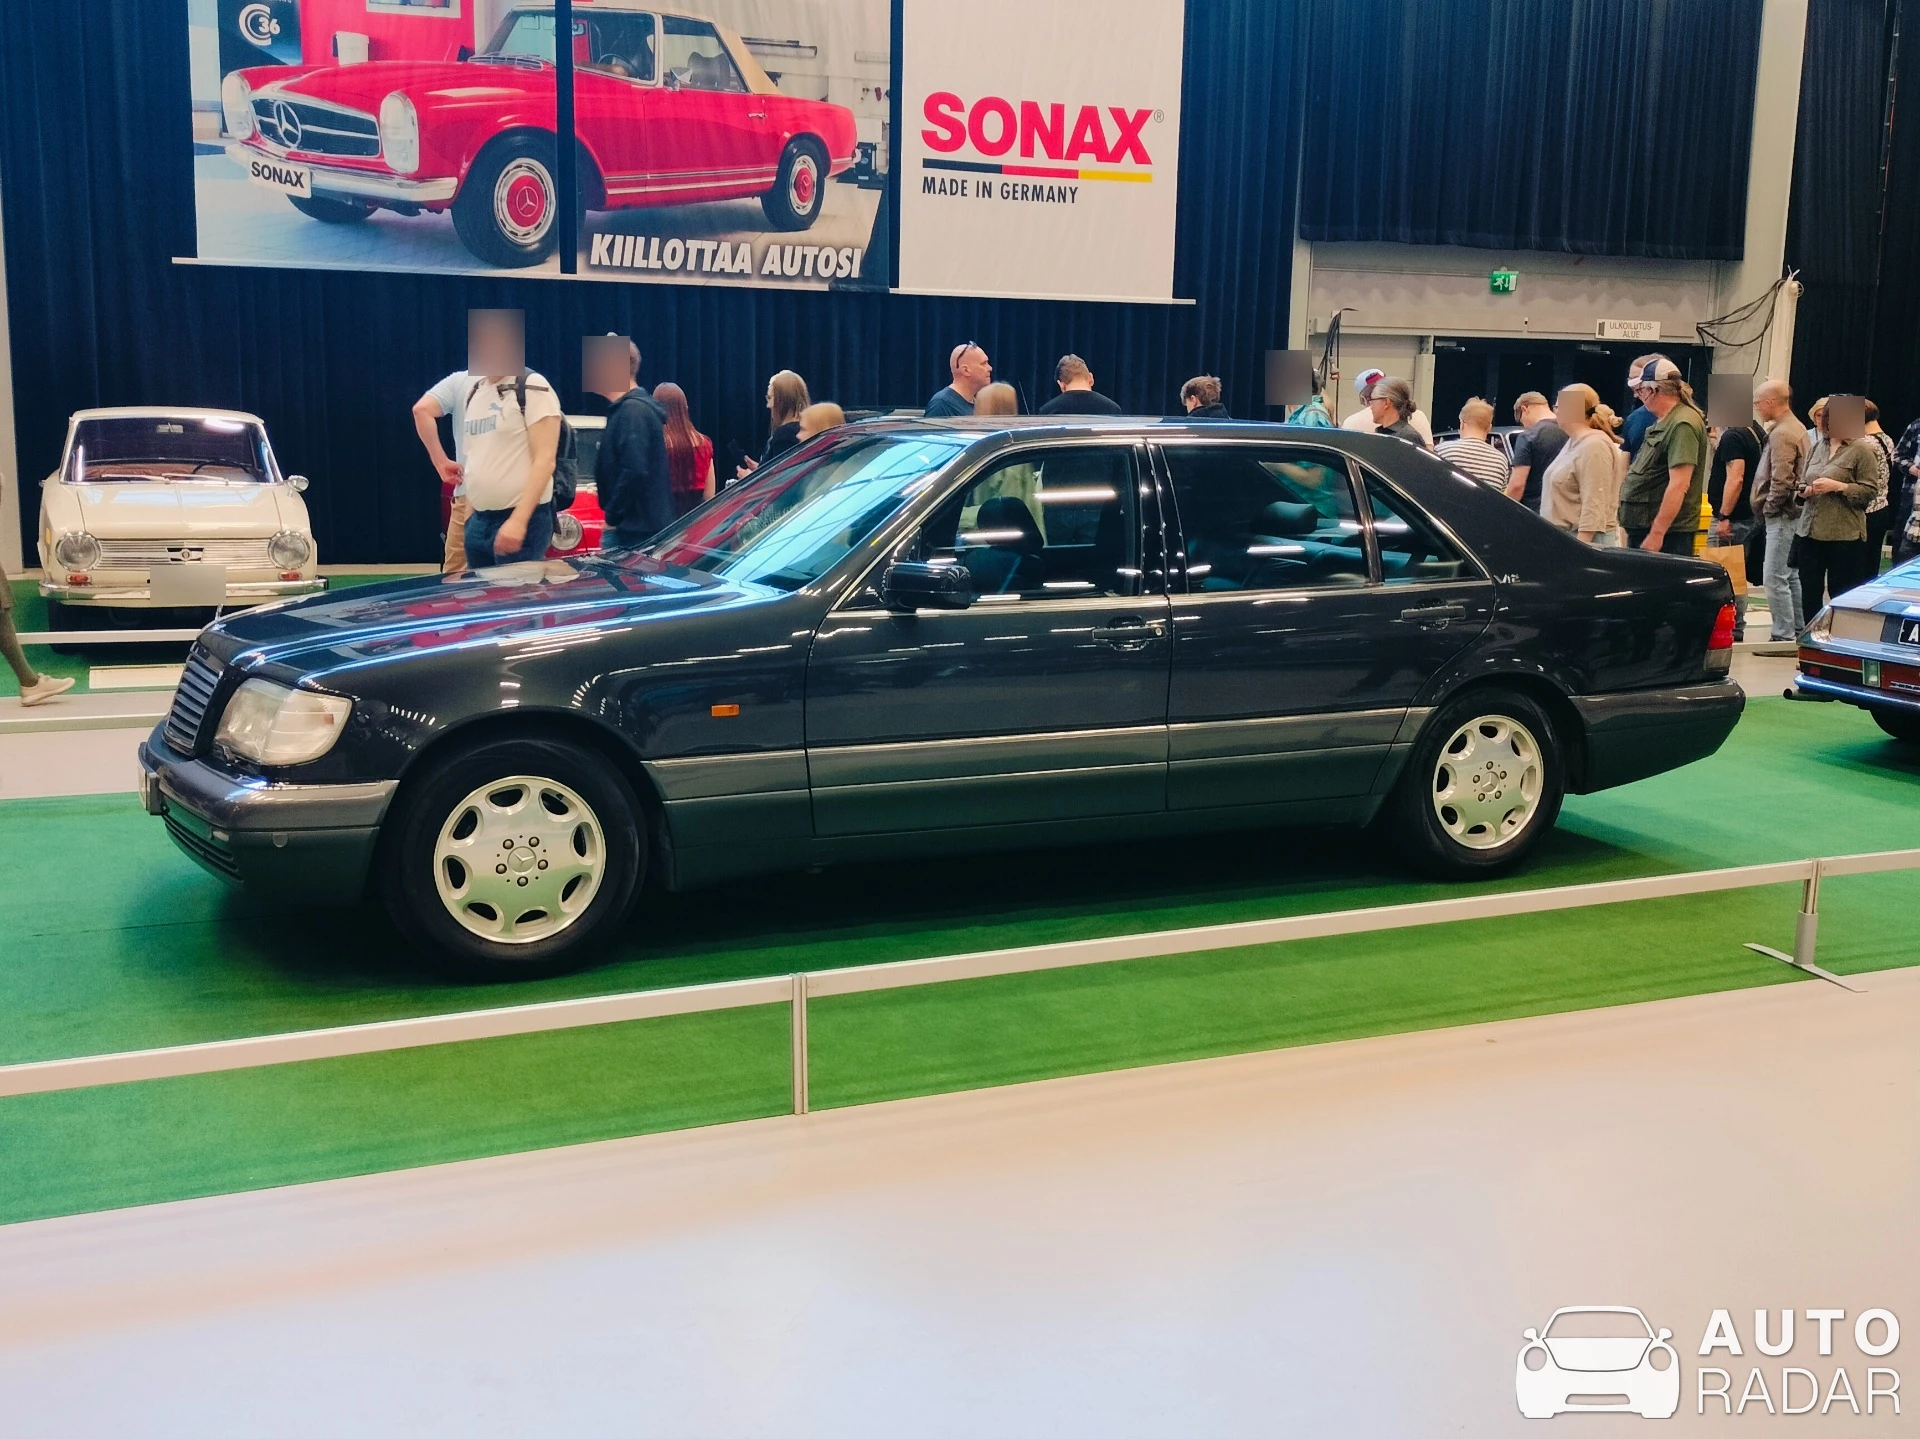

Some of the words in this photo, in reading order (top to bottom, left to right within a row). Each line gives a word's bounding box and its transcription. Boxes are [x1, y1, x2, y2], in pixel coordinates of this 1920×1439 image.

[251, 161, 305, 189] SONAX
[922, 176, 968, 197] MADE
[976, 180, 992, 198] IN
[1000, 182, 1079, 204] GERMANY
[590, 233, 752, 274] KIILLOTTAA
[761, 244, 862, 278] AUTOSI
[1609, 321, 1654, 331] ULKOILUTUS-
[1622, 330, 1640, 339] ALUE
